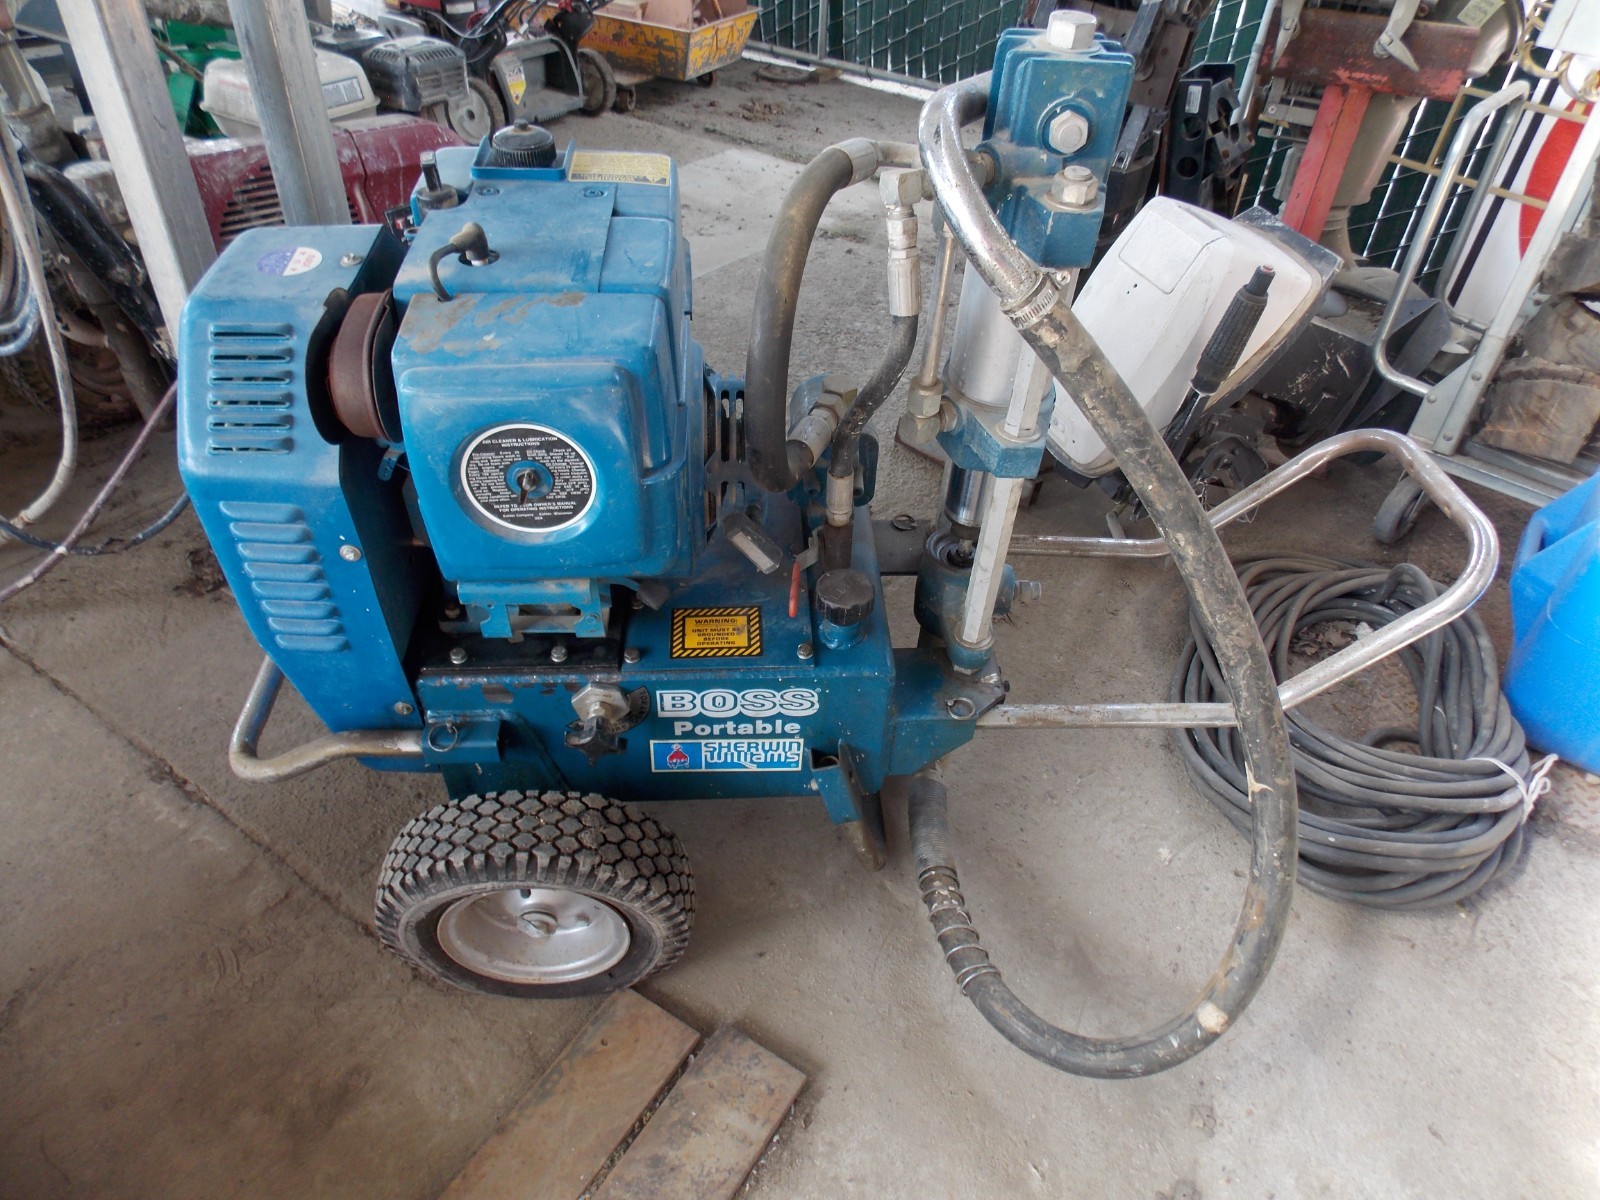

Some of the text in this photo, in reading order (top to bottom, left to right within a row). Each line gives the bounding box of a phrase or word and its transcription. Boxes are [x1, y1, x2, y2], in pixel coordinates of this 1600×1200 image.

[656, 689, 819, 718] BOSS
[674, 720, 801, 736] Portable
[703, 741, 801, 753] SHERWIN
